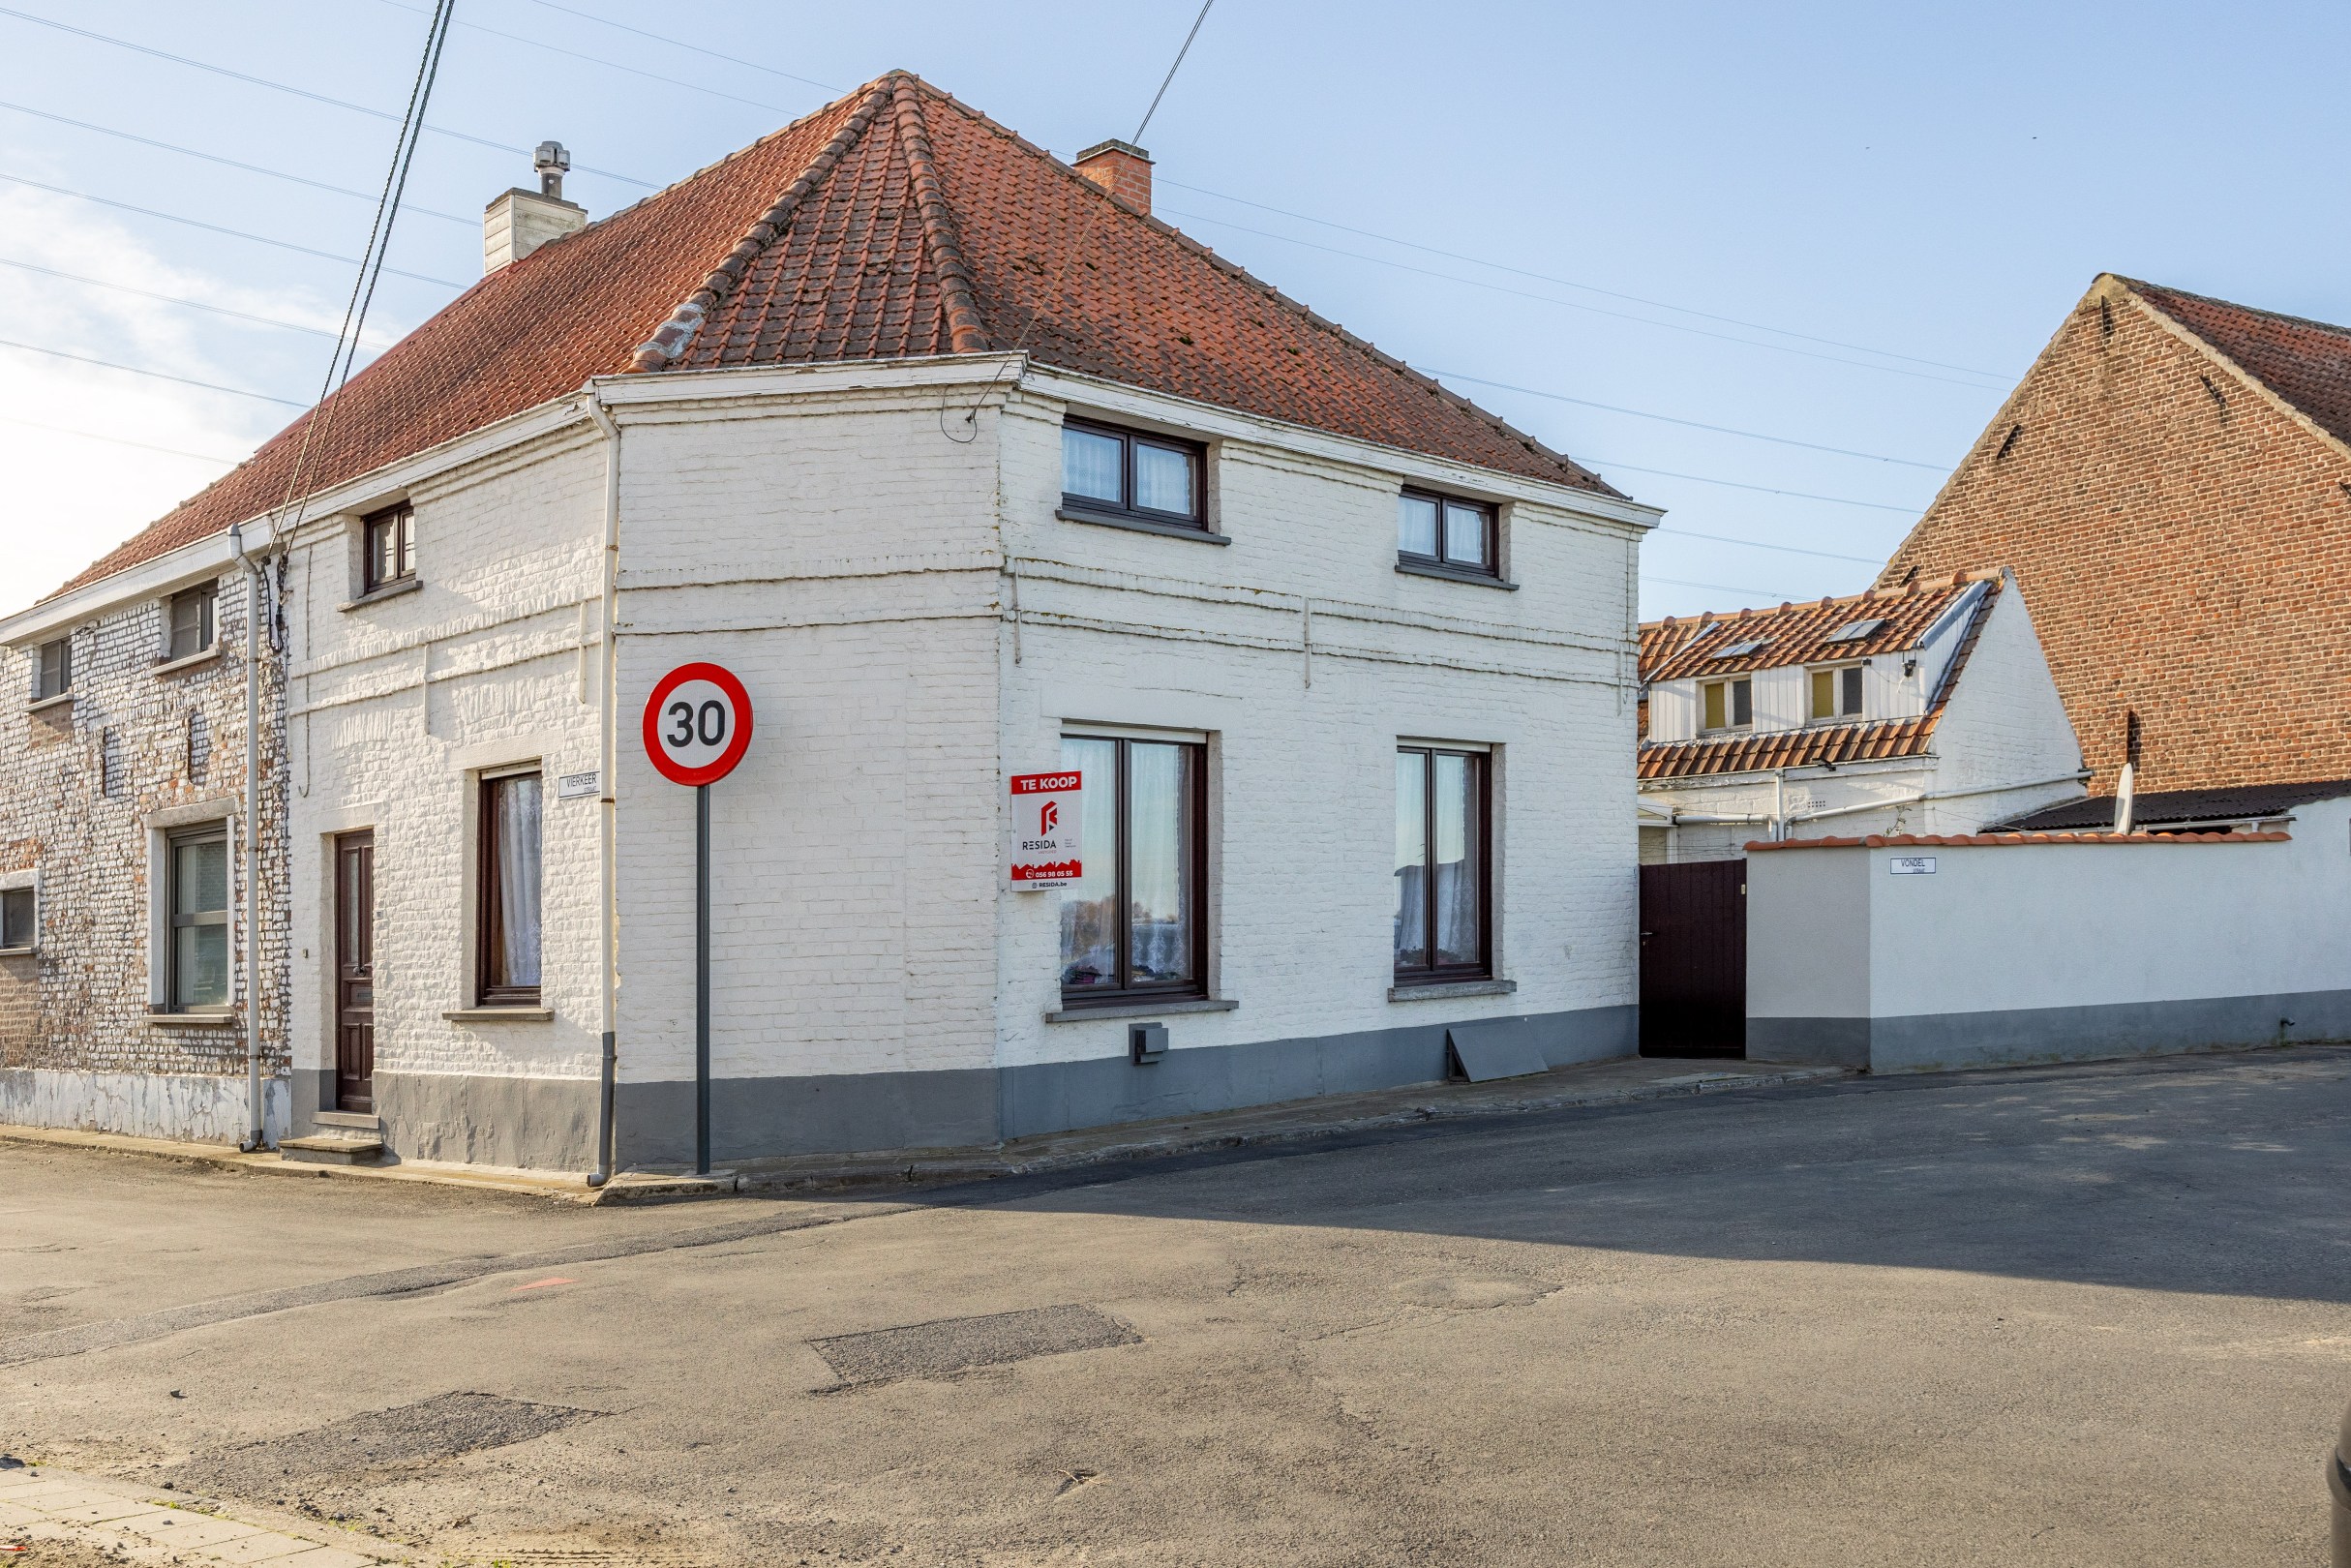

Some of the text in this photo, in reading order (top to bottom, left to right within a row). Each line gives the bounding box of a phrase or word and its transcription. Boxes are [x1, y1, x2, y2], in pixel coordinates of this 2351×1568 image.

[667, 700, 725, 747] 30
[567, 773, 596, 788] VIERKEER
[1020, 776, 1077, 791] TE KOOP
[1022, 840, 1056, 850] RESIDA
